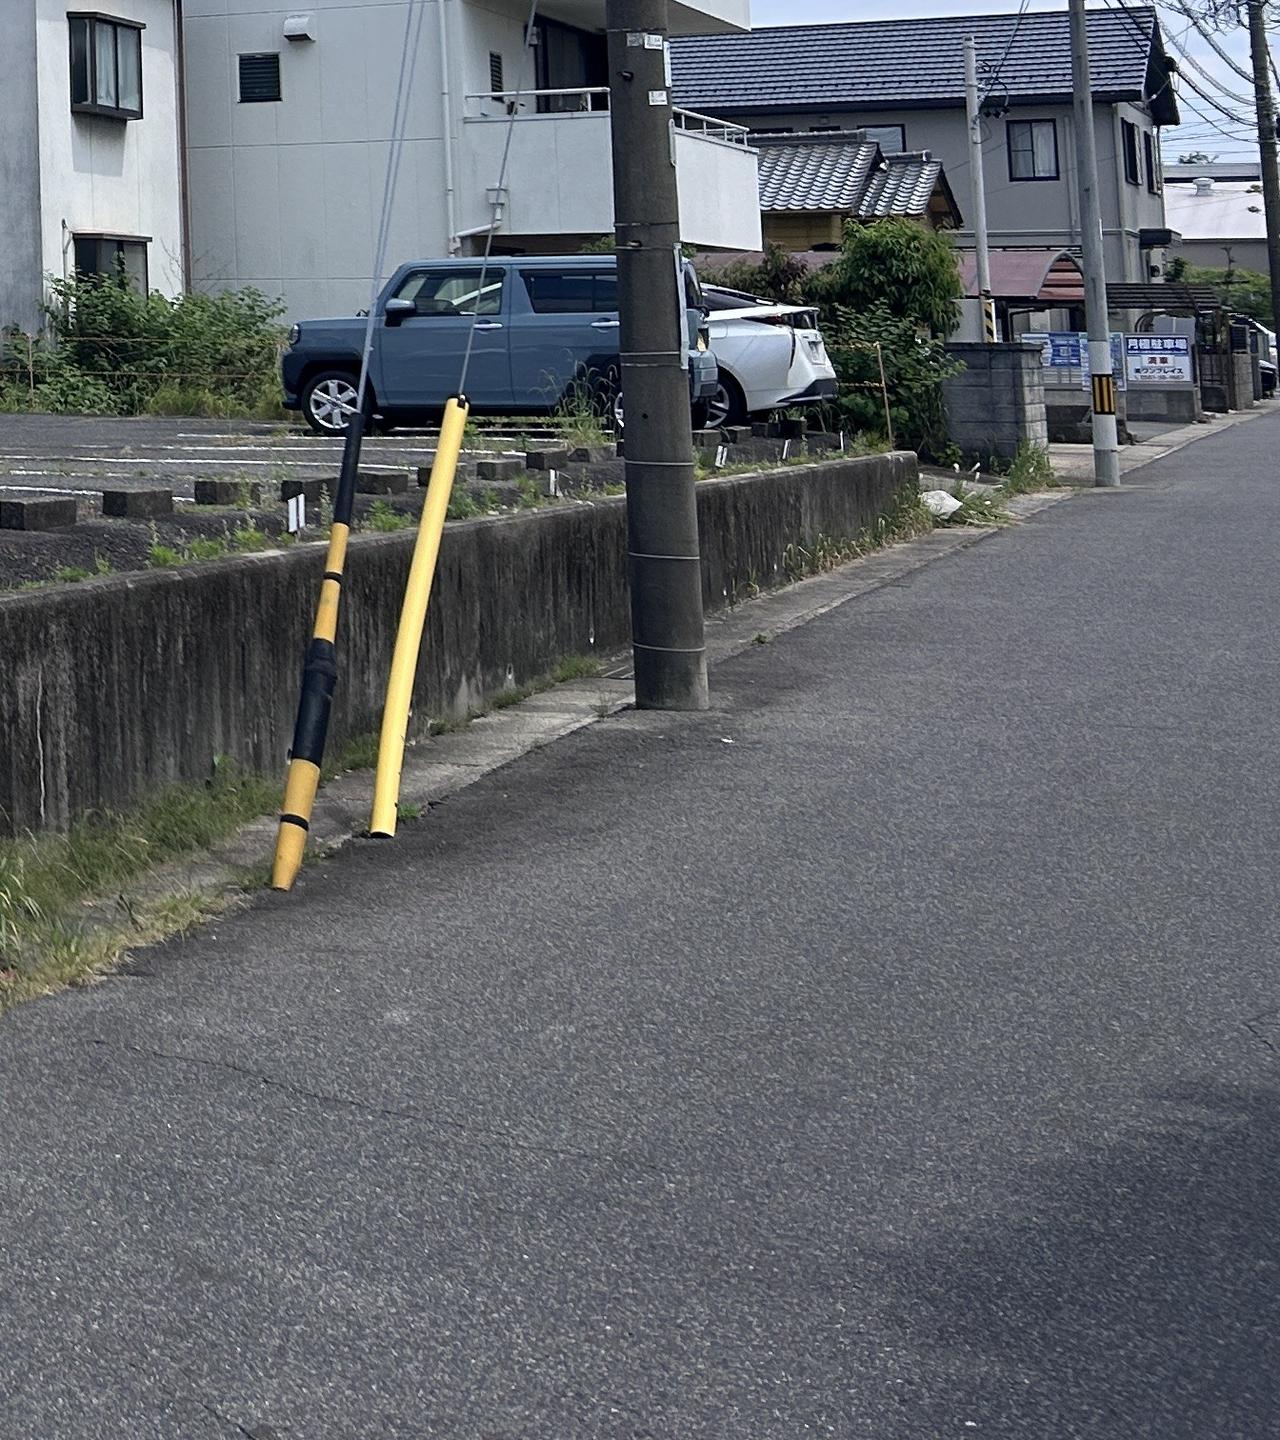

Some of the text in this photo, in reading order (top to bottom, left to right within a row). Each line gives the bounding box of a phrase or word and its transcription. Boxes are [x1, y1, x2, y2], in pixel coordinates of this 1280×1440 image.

[1128, 338, 1187, 349] 月極駐車場
